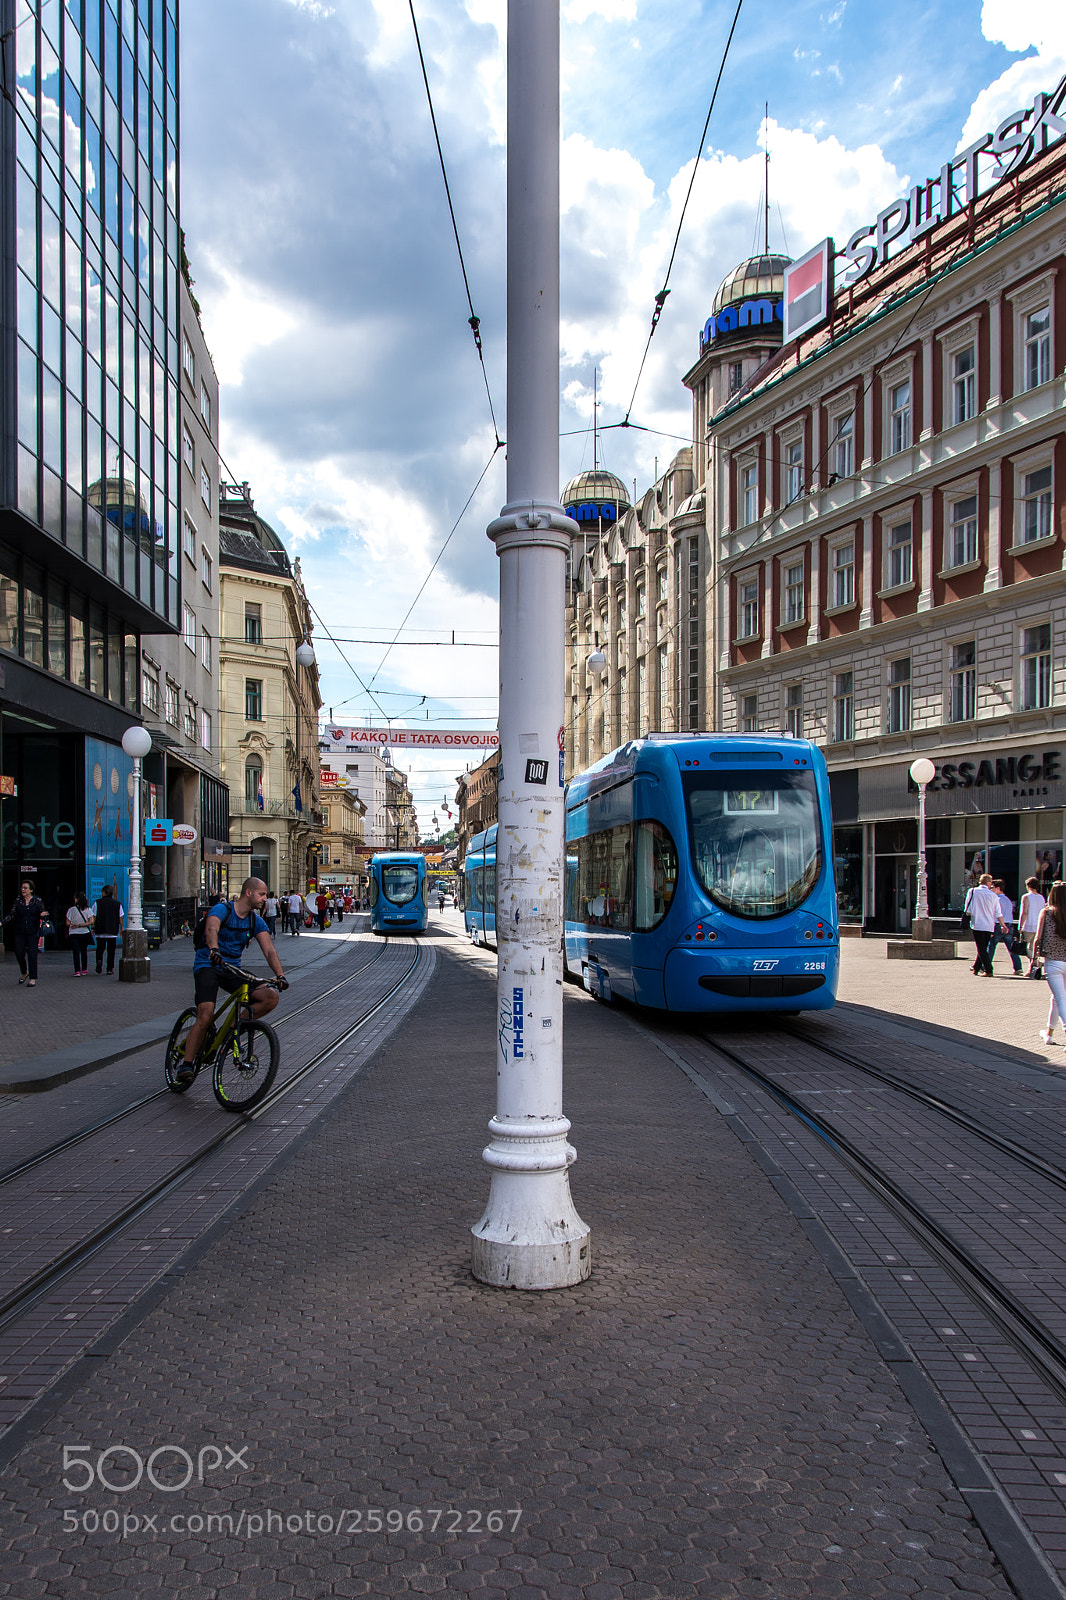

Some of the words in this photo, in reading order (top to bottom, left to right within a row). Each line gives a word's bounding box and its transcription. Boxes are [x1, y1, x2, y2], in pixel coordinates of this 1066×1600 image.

[703, 299, 783, 344] nam
[350, 731, 388, 744] KAKO
[391, 733, 407, 744] JE
[410, 734, 441, 744] TATA
[444, 735, 499, 745] OSVOJIO
[1013, 787, 1048, 797] PARIS
[738, 791, 761, 810] 17
[752, 959, 780, 971] ZET
[804, 962, 826, 970] 2268
[513, 987, 524, 1058] SONIC
